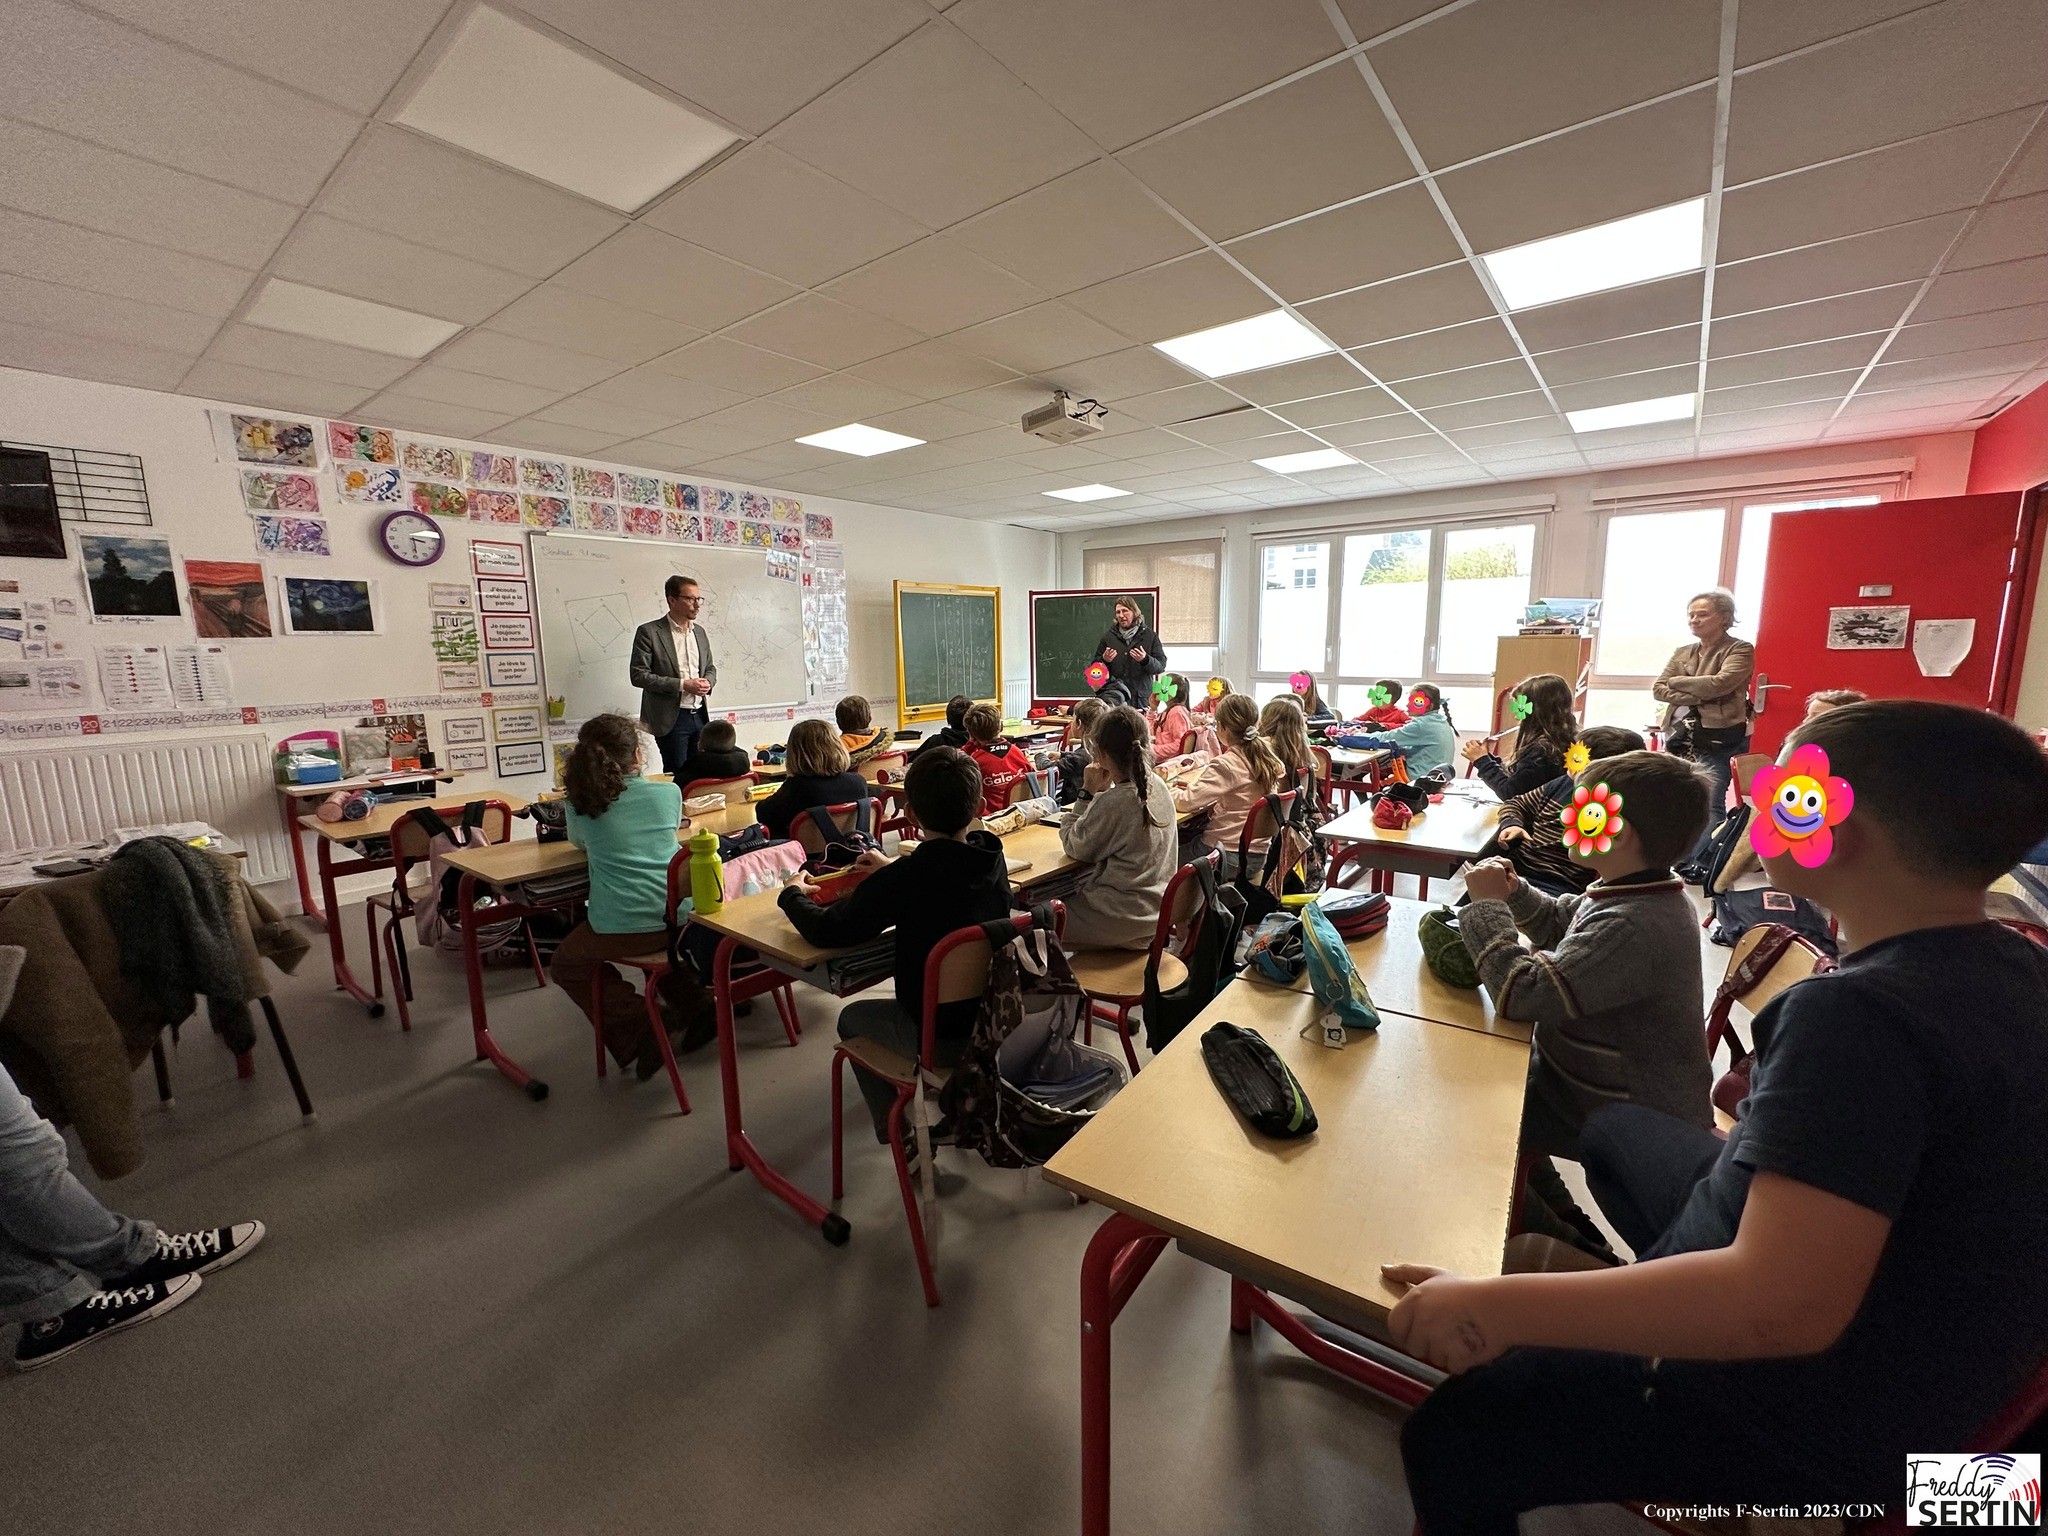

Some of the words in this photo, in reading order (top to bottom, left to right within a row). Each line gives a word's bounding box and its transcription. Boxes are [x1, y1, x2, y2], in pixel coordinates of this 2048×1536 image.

[803, 573, 810, 586] H
[10, 725, 26, 734] 16
[29, 724, 44, 732] 17
[48, 723, 62, 731] 18
[66, 722, 79, 730] 19
[82, 720, 98, 729] 20
[103, 718, 117, 728] 21
[120, 718, 133, 727] 22
[135, 718, 149, 726] 23
[152, 718, 164, 726] 24
[167, 716, 181, 725] 25
[229, 712, 242, 720] 29
[244, 712, 255, 720] 30
